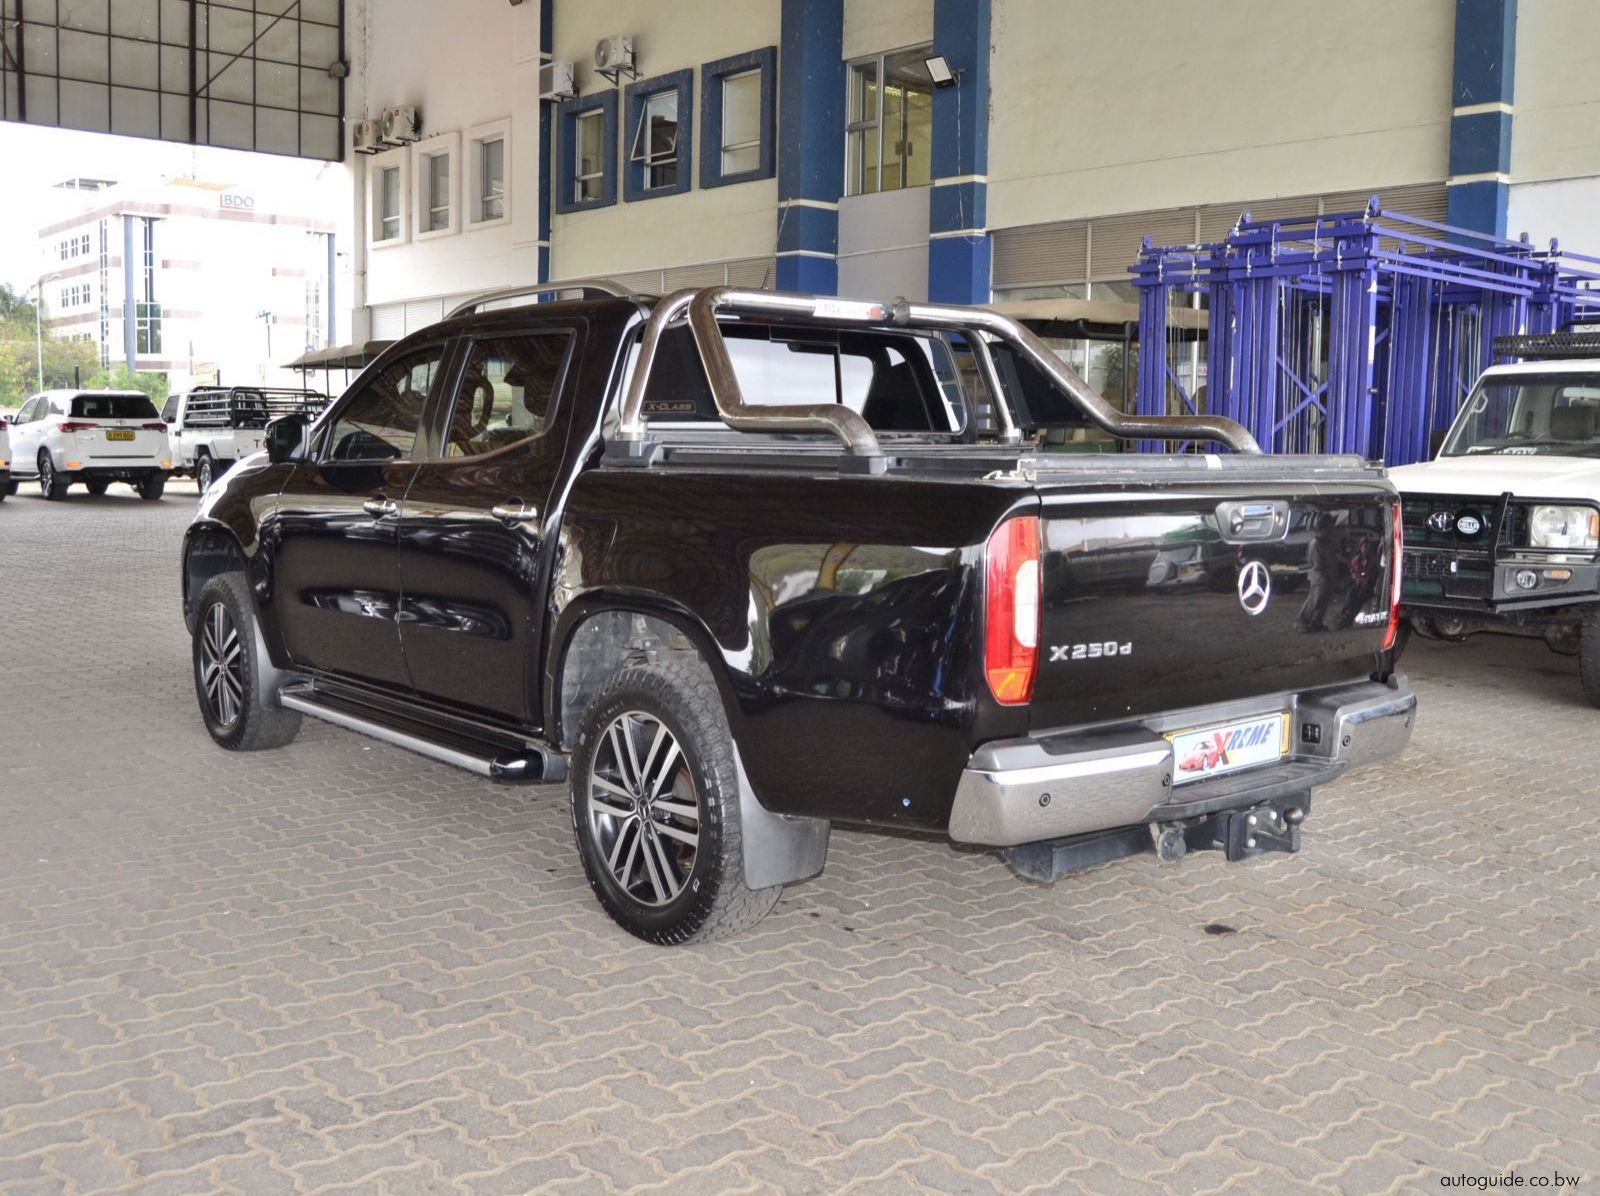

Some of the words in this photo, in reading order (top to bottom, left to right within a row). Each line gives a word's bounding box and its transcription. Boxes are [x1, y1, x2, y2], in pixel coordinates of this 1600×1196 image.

[224, 194, 254, 208] BDO
[1049, 644, 1069, 662] X
[1071, 641, 1132, 659] 250d
